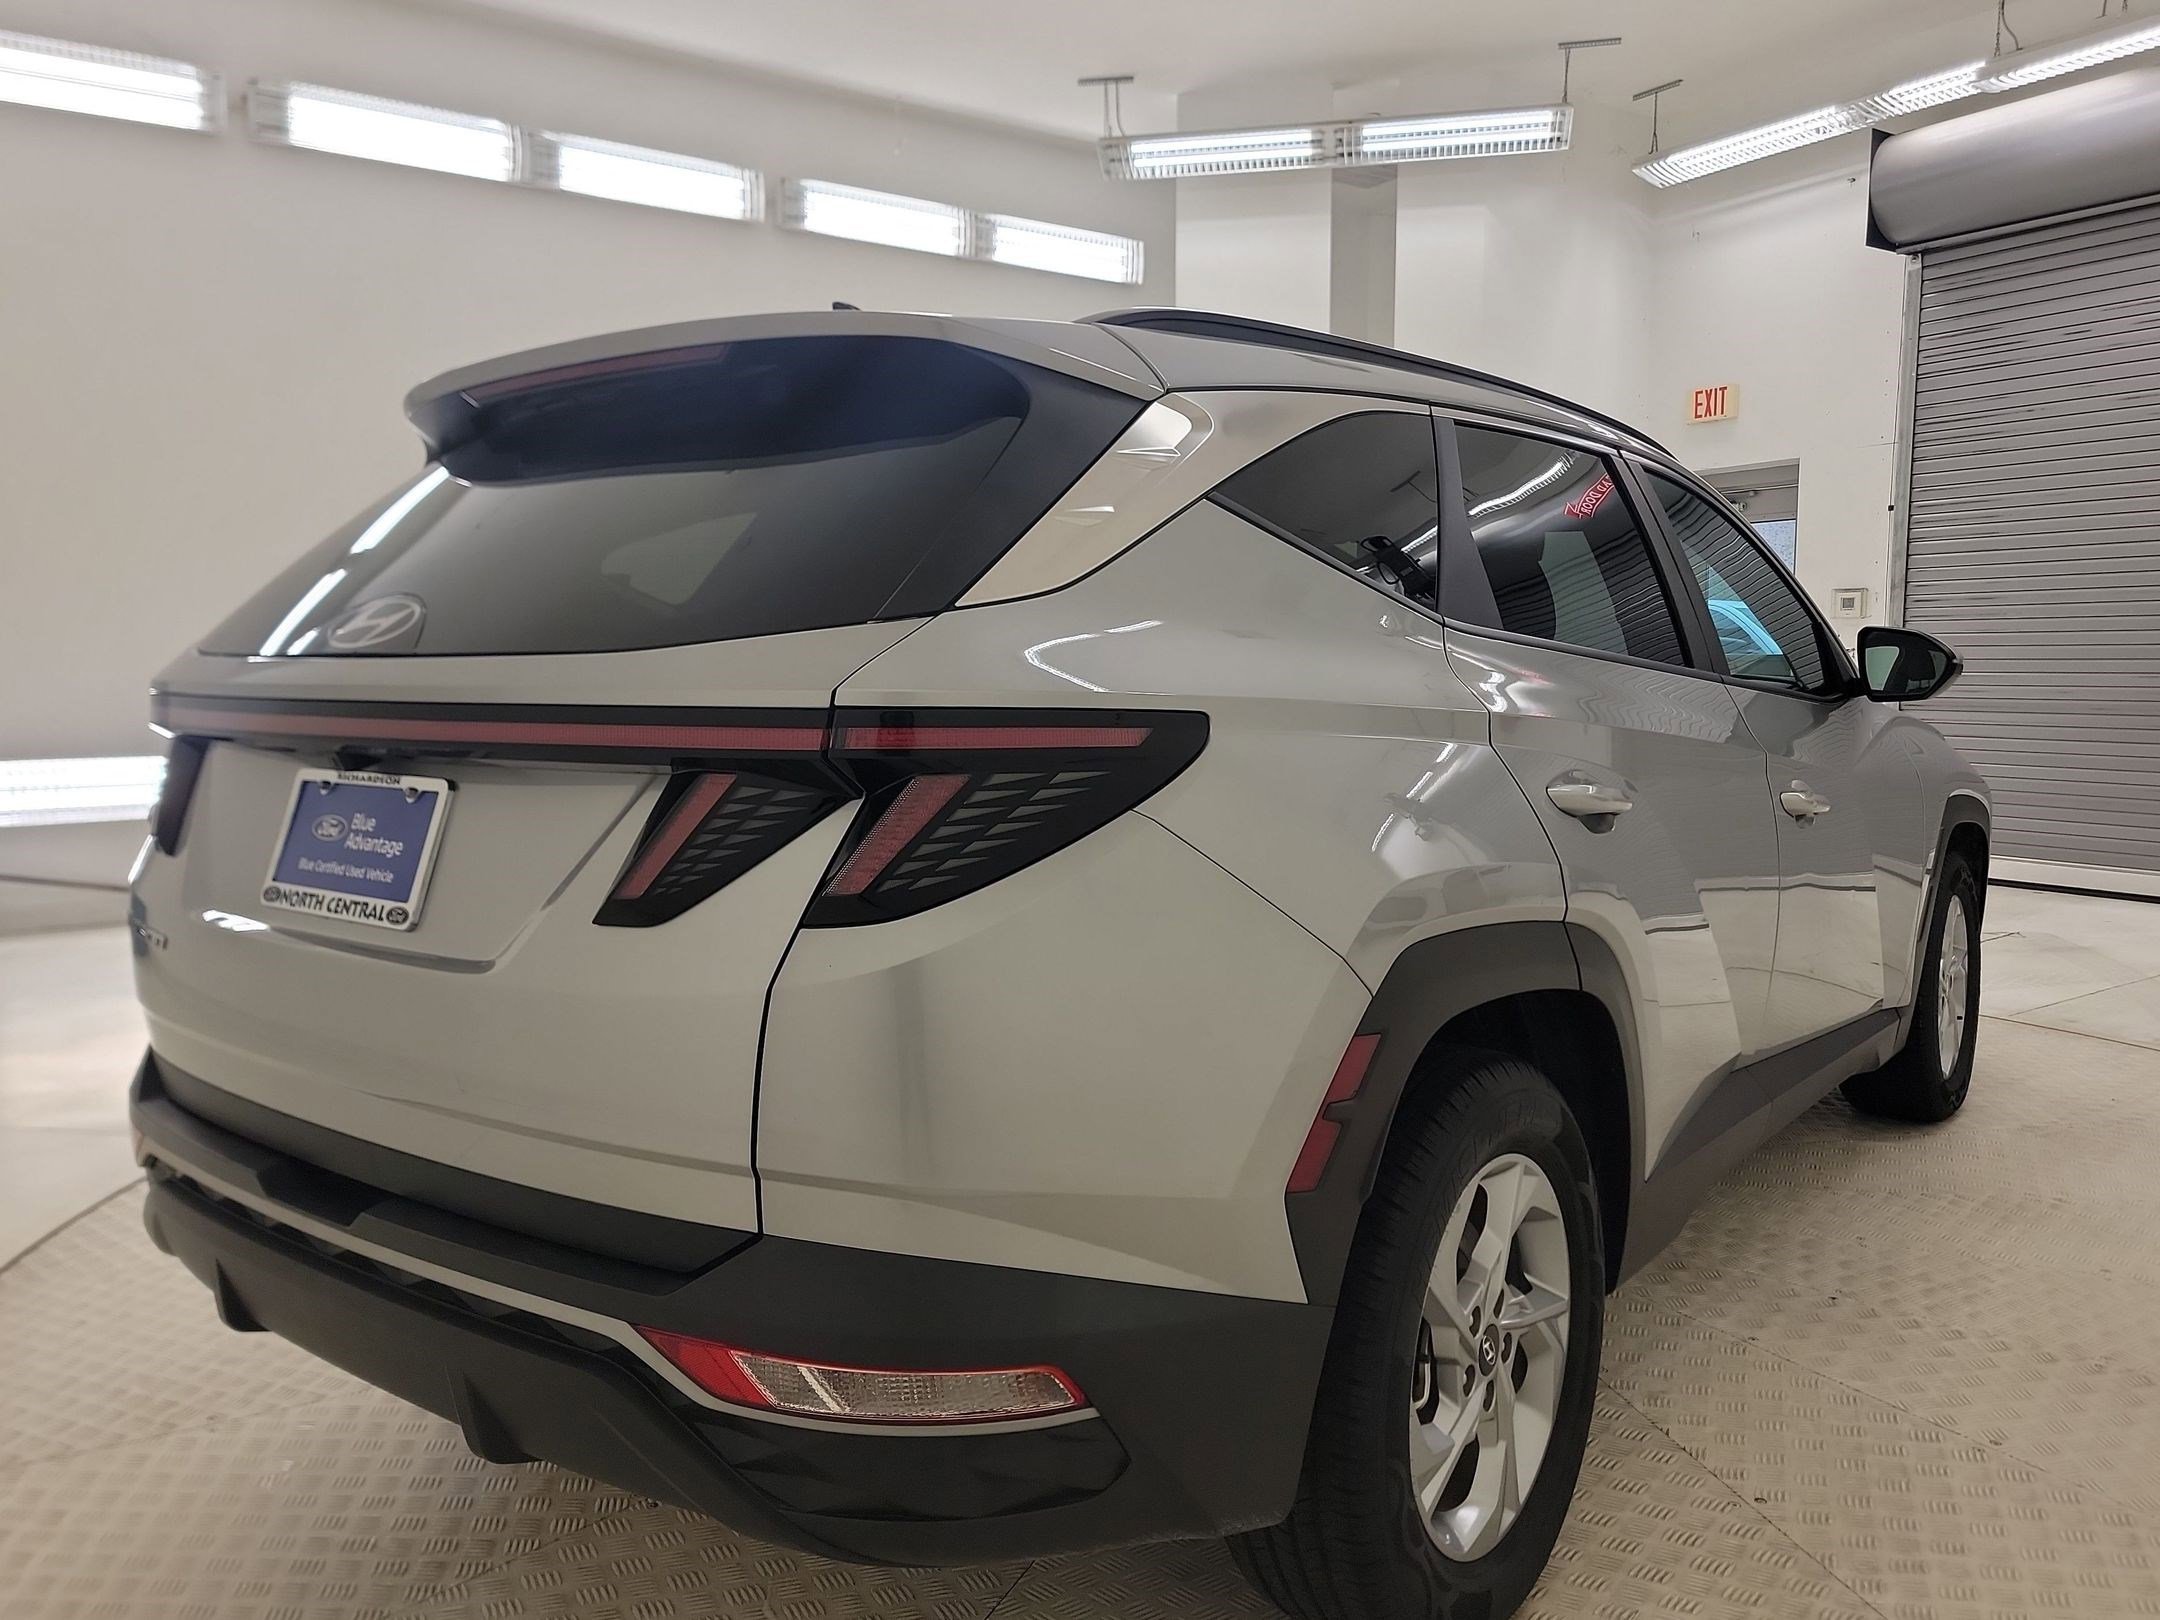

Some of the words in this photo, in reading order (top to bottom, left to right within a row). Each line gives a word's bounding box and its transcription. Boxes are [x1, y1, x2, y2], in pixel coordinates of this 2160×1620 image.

[1694, 386, 1728, 419] EXIT
[351, 813, 376, 832] Blue
[344, 832, 403, 858] Advantage
[298, 857, 314, 872] Blue
[315, 860, 345, 876] Certified
[345, 864, 366, 879] Used
[366, 867, 394, 883] Vehicle
[279, 888, 325, 912] NORTH
[326, 897, 385, 922] CENTRAL
